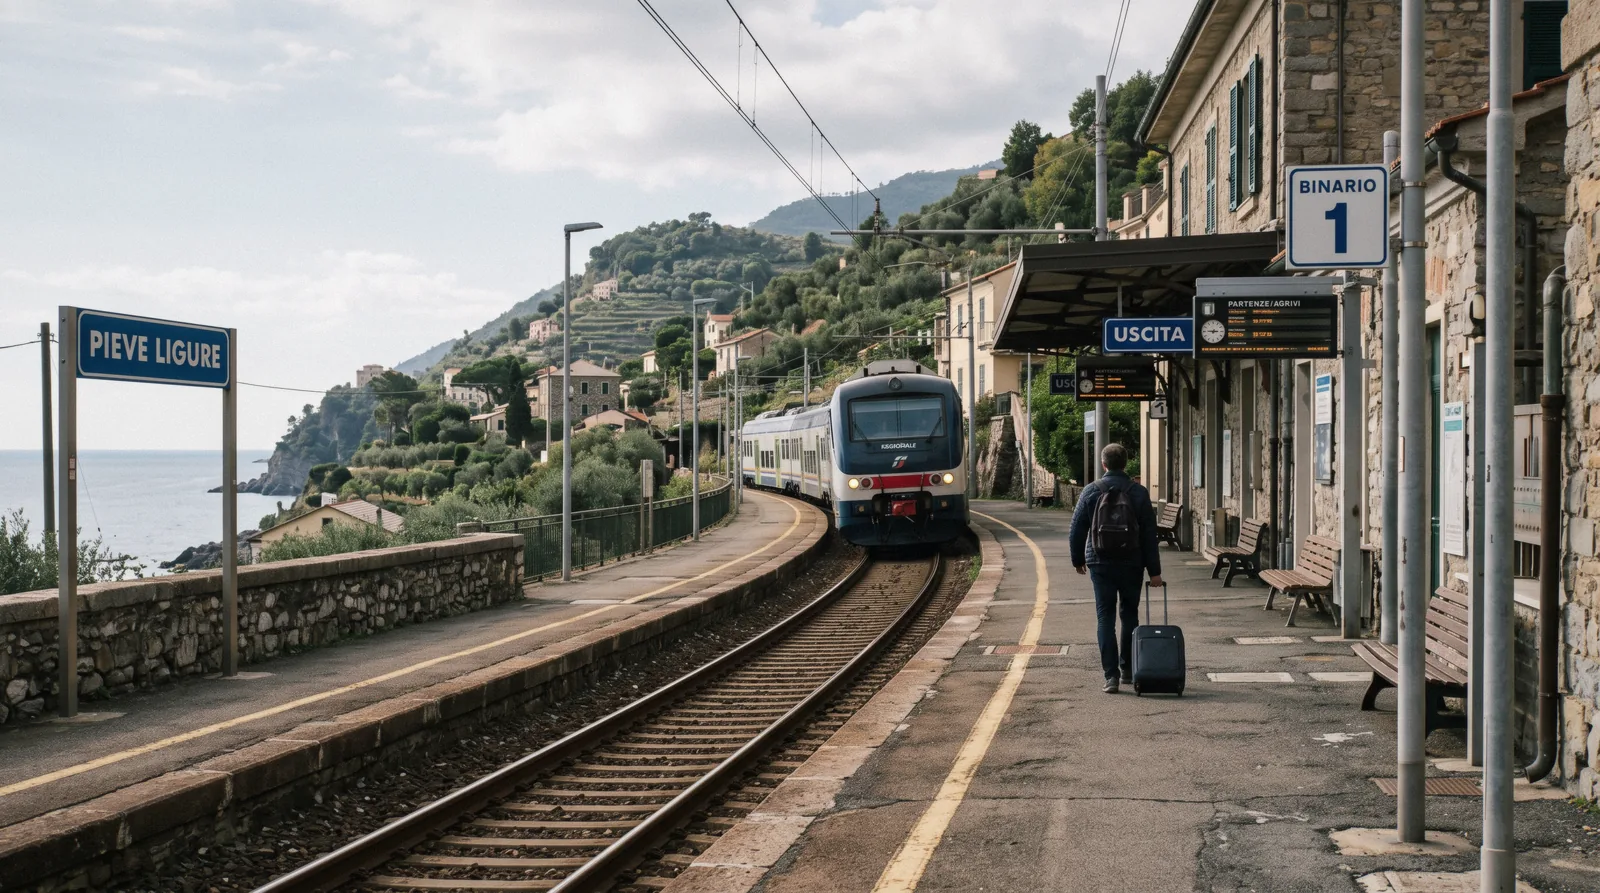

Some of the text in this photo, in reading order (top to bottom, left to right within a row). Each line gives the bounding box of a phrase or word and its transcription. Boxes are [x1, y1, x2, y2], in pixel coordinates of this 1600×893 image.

[1300, 179, 1376, 193] BINARIO
[1325, 203, 1347, 253] 1
[1114, 327, 1186, 342] USCITA
[90, 330, 221, 368] PIEVE LIGURE
